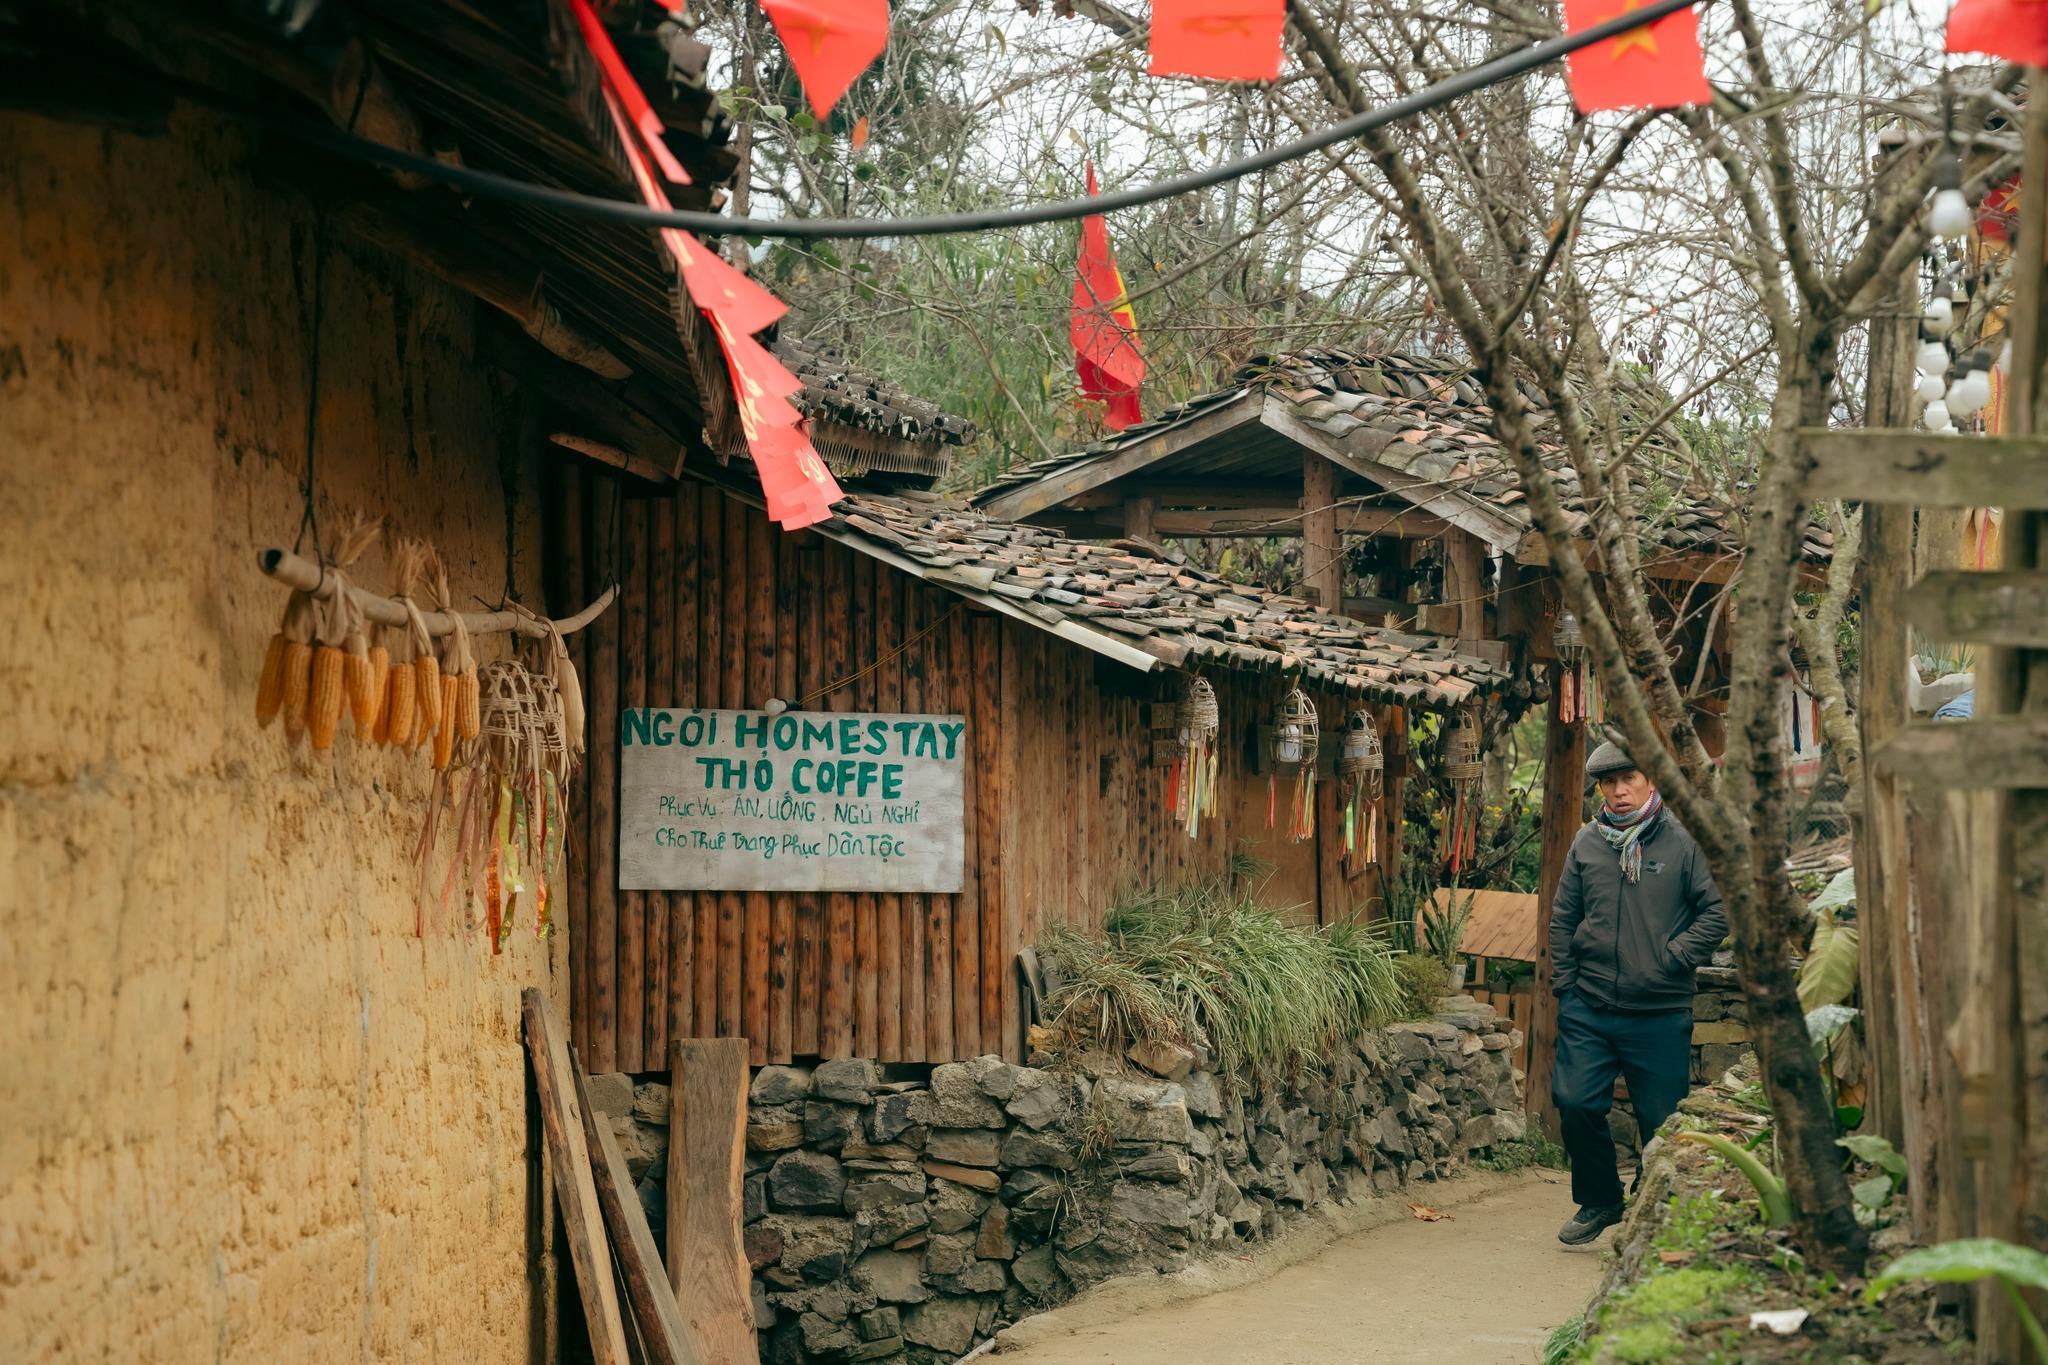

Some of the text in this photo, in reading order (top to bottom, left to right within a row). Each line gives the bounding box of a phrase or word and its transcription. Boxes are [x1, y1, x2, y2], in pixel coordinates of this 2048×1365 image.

[735, 714, 965, 760] HOMESTAY
[792, 758, 904, 799] COFFE
[658, 795, 695, 820] Phục
[655, 827, 688, 848] Cho
[690, 831, 727, 850] Thuê
[732, 831, 779, 859] Trang
[781, 833, 821, 859] Phục
[866, 833, 906, 863] Tộc
